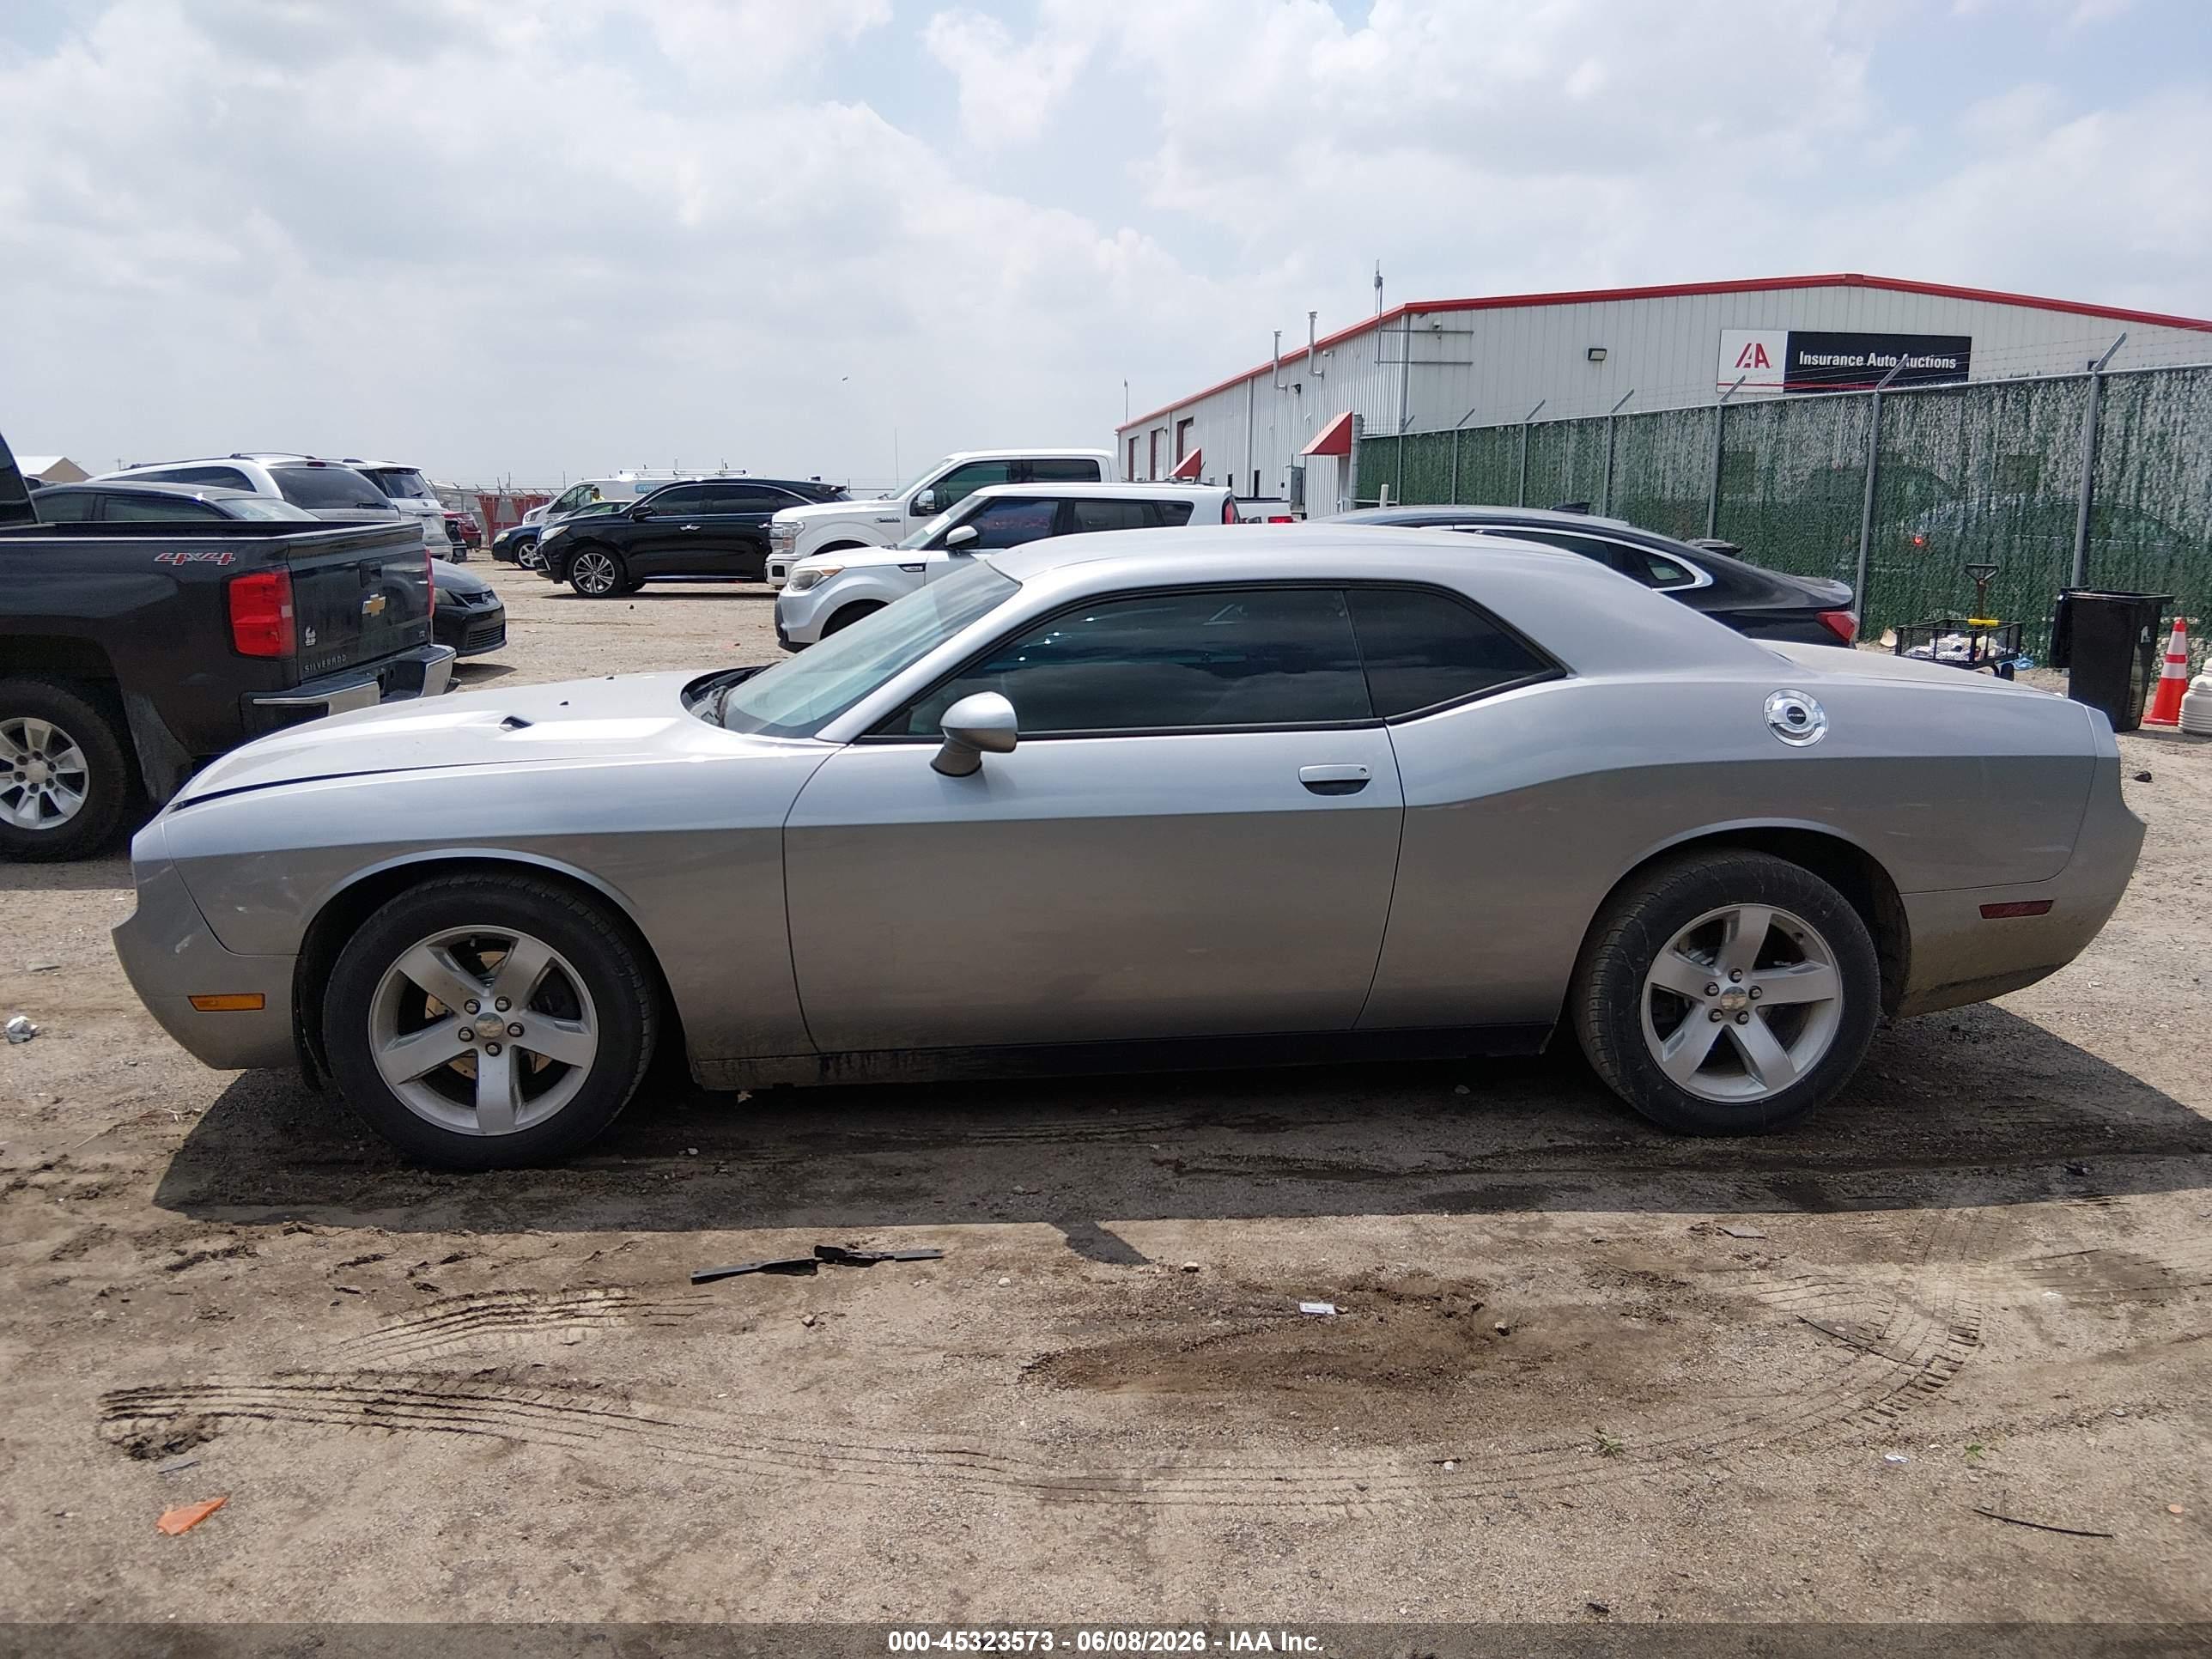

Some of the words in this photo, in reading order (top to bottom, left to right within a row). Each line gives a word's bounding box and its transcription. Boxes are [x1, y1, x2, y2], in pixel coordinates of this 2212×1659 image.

[1799, 350, 1864, 367] Insurance
[1866, 352, 1897, 368] Auto
[304, 654, 347, 673] SILVERADO
